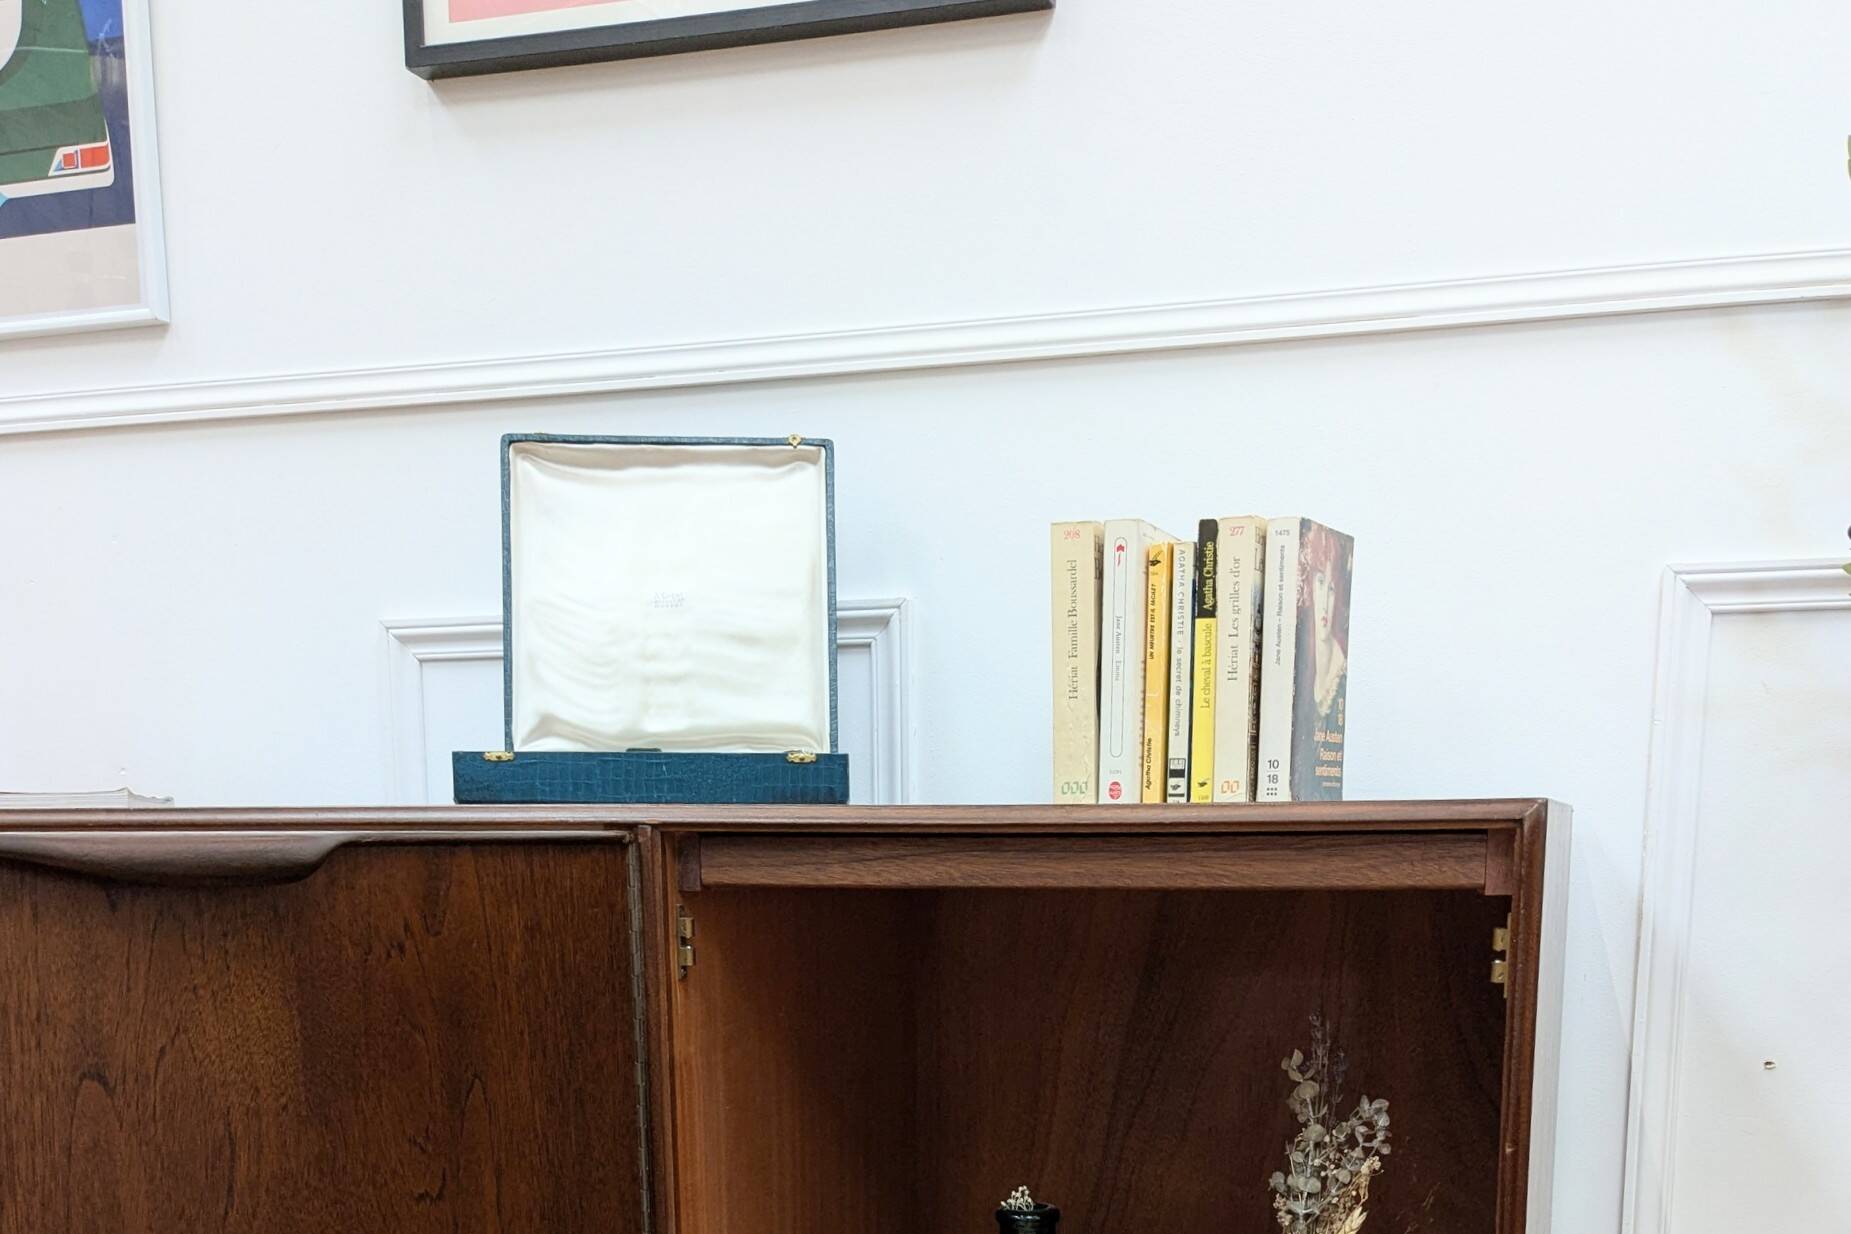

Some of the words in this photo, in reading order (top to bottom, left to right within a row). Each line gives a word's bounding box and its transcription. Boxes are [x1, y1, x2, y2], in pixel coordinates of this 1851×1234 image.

[1177, 549, 1186, 588] AGATHA
[1203, 541, 1214, 577] Christie
[1229, 556, 1241, 578] d'or
[1067, 559, 1079, 618] Boussardel
[1203, 579, 1214, 610] Agatha
[1229, 581, 1241, 615] grilles
[1176, 592, 1185, 635] CHRISTIE
[1228, 617, 1240, 638] Les
[1068, 620, 1079, 660] Famille
[1202, 622, 1213, 657] bascule
[1175, 657, 1184, 683] secret
[1202, 658, 1211, 666] à
[1227, 645, 1238, 681] Hériat
[1175, 685, 1184, 695] de
[1201, 668, 1211, 696] cheval
[1200, 697, 1210, 709] Le
[1173, 698, 1184, 737] chimneys
[1145, 737, 1153, 764] Christie
[1266, 759, 1280, 770] 10
[1145, 765, 1153, 790] Agatha
[1266, 774, 1279, 784] 18
